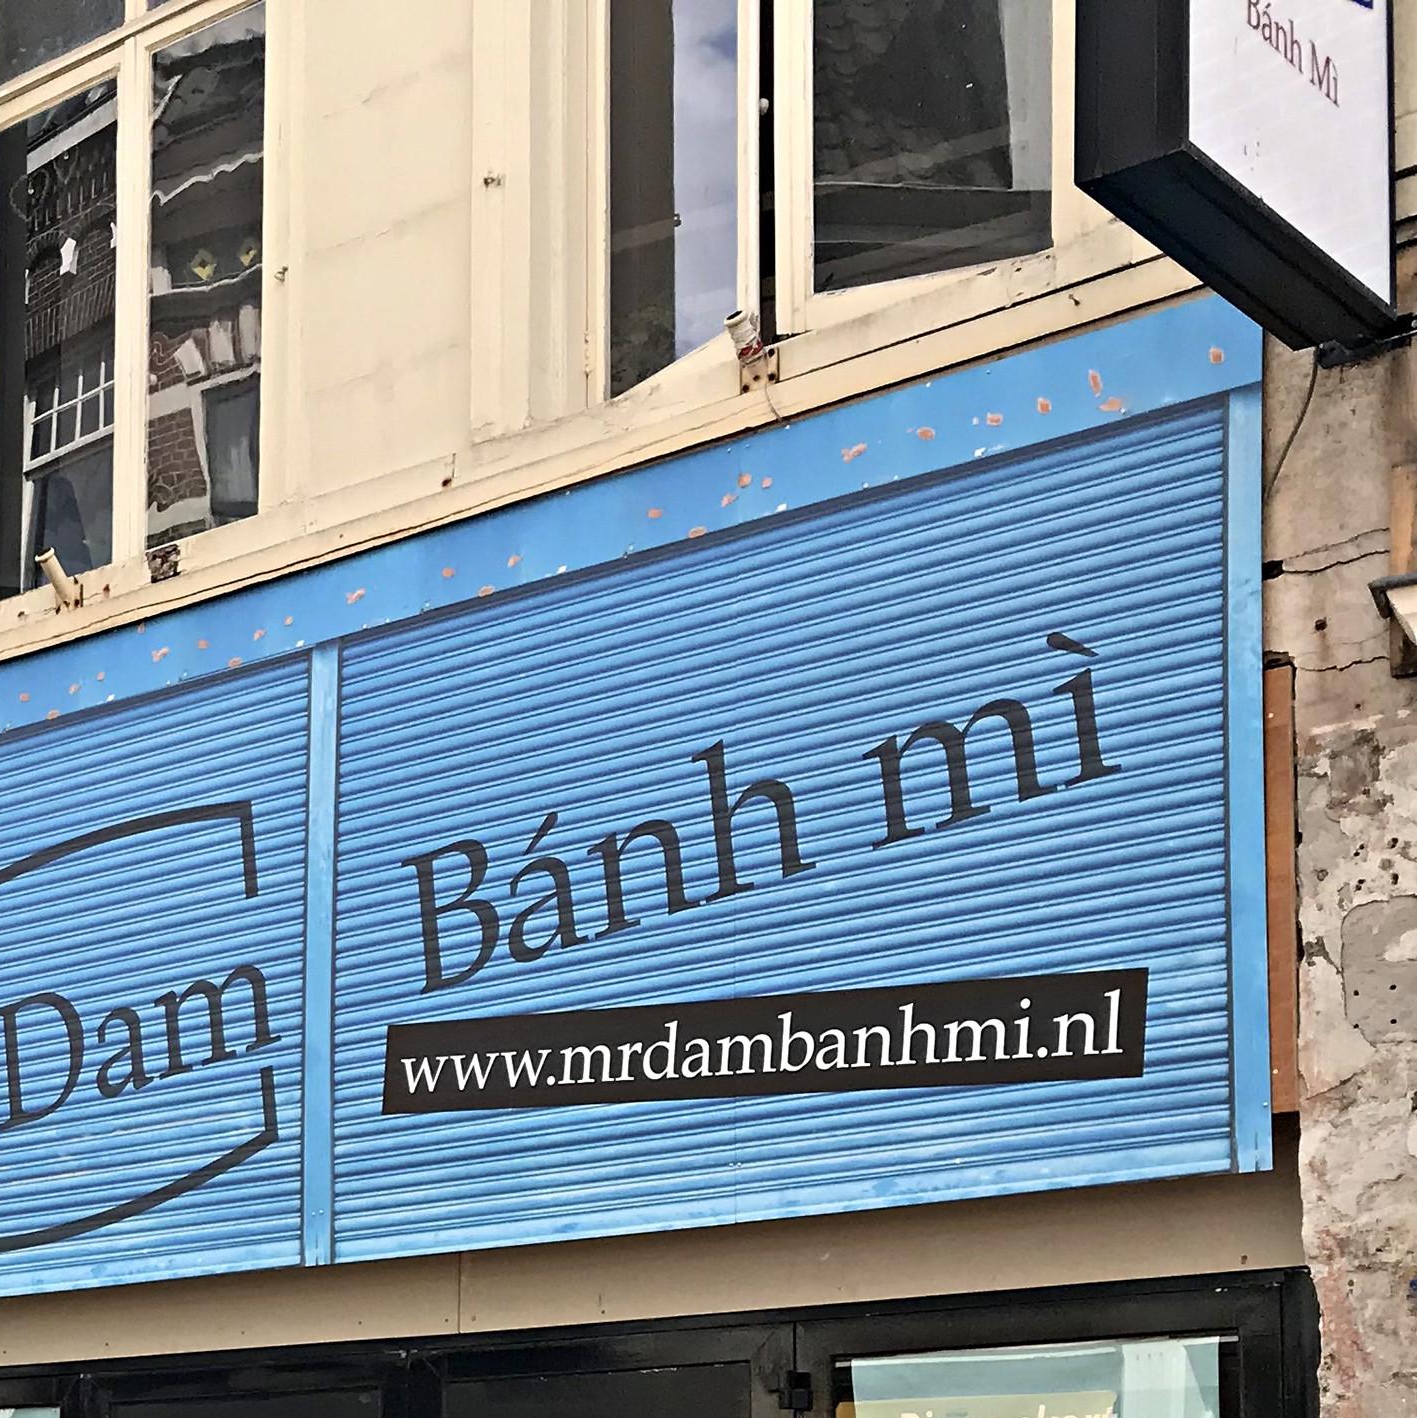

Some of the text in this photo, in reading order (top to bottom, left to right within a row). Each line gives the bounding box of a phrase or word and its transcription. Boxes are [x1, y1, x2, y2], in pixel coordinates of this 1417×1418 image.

[401, 632, 1121, 995] Bánh mì
[400, 989, 1124, 1095] www.mrdambanhmi.nl
